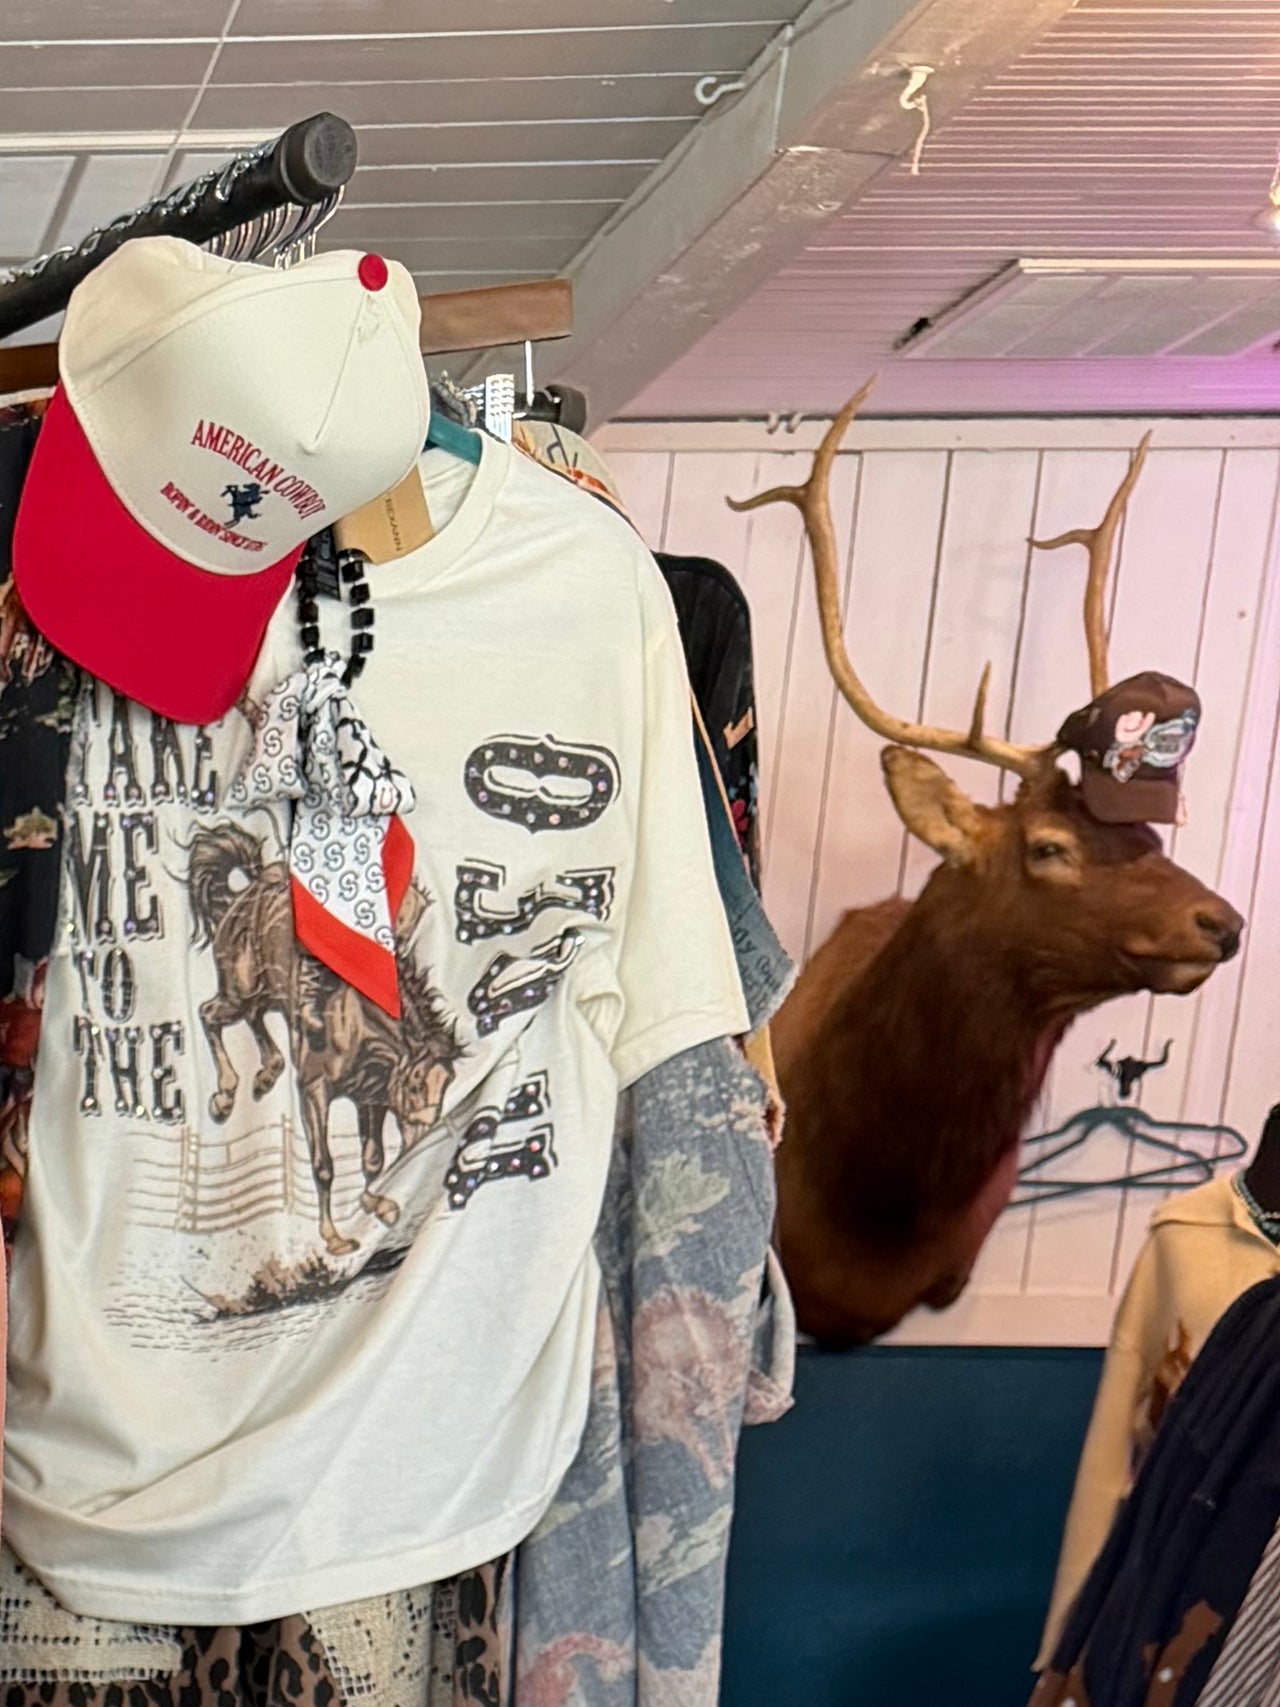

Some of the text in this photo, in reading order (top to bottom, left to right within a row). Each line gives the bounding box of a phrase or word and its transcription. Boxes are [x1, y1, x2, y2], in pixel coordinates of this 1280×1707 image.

[190, 419, 285, 486] AMERICAN
[66, 811, 164, 944] ME
[73, 948, 136, 1023] TO
[443, 734, 623, 1210] RDEO
[73, 1015, 186, 1125] THE
